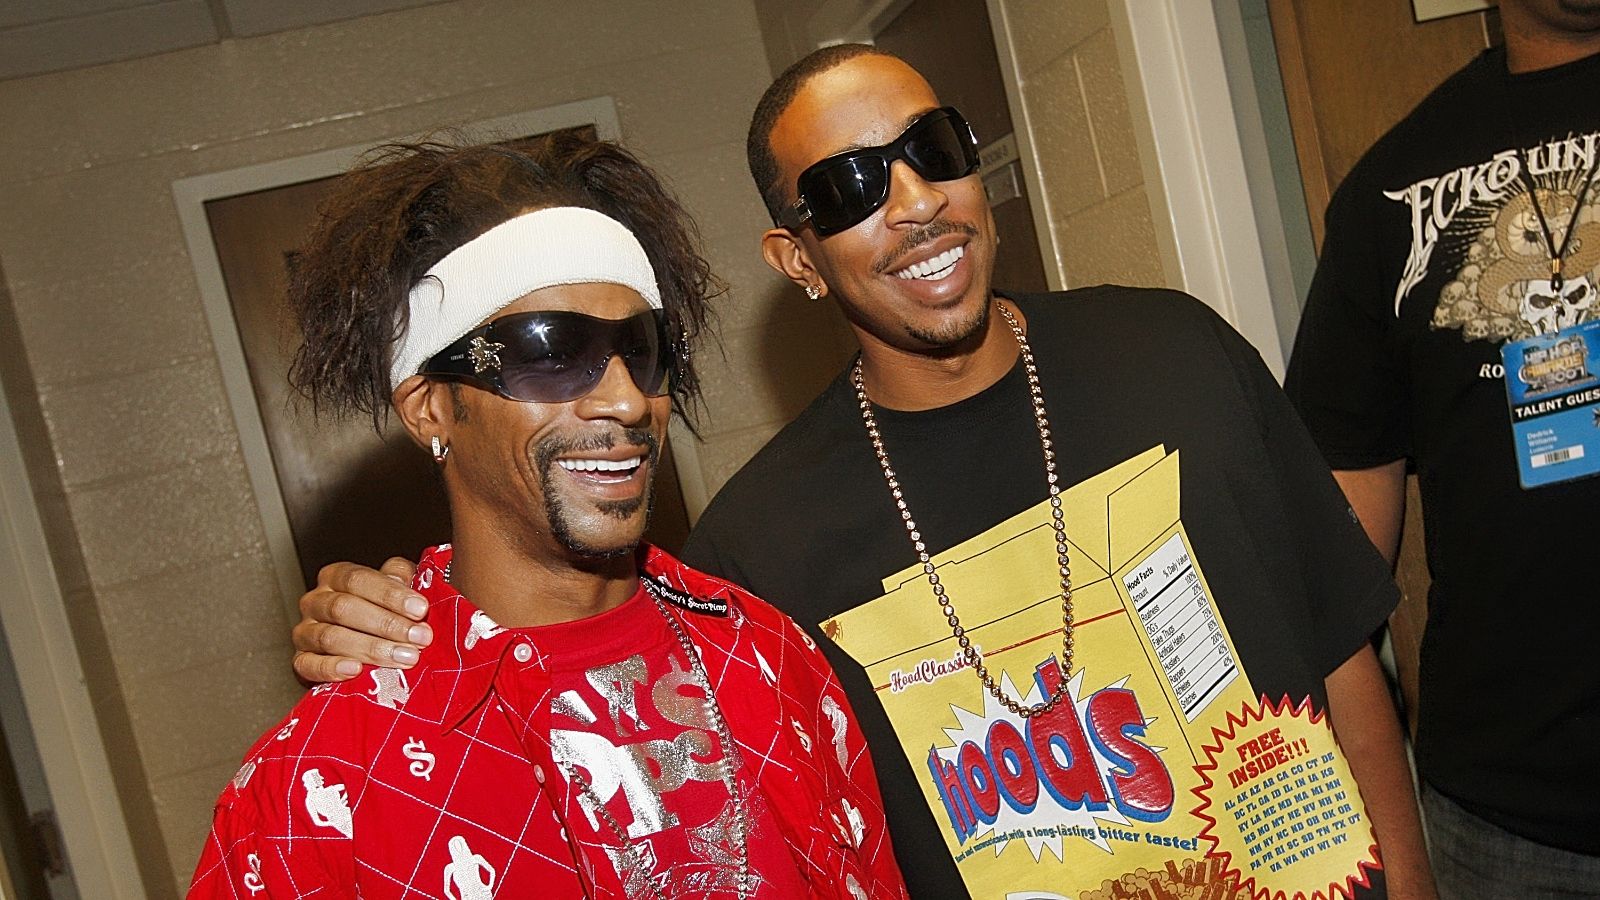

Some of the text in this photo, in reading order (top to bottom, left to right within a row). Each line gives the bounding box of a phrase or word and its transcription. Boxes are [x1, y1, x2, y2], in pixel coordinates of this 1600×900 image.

[1527, 133, 1597, 176] UN
[1515, 397, 1563, 418] TALENT
[1126, 566, 1155, 592] Hood Facts
[1132, 586, 1149, 603] Amount
[1167, 562, 1179, 576] Daily
[1176, 553, 1189, 567] Value
[708, 603, 727, 613] Pimp
[1140, 604, 1160, 622] Realness
[1152, 635, 1163, 647] Fake
[1161, 625, 1175, 638] Thugs
[1172, 632, 1186, 647] Haters
[891, 652, 981, 692] HoodClassic
[1163, 655, 1181, 672] Hustlers
[1169, 667, 1186, 684] Rappers
[1181, 691, 1197, 709] Snitches
[1227, 737, 1310, 789] INSIDE!!!
[1236, 727, 1285, 763] FREE
[1224, 752, 1334, 810] AL AK AZ AR CA CO CT DE
[1234, 767, 1334, 820] DC FL GA ID IL IN IA KS
[1238, 778, 1341, 832] KY LA ME MD MA MI MN
[1244, 790, 1346, 844] MS MO MT NE NV NH NJ
[1008, 828, 1025, 840] with
[1034, 825, 1096, 840] long-lasting
[1098, 826, 1140, 842] bitter
[1145, 832, 1198, 851] taste!
[1249, 803, 1352, 856] NM NY NC ND OH OK OR
[1250, 813, 1361, 871] PA PR RI SC SD TN TX UT
[1270, 833, 1348, 872] VA WA WV WI WY
